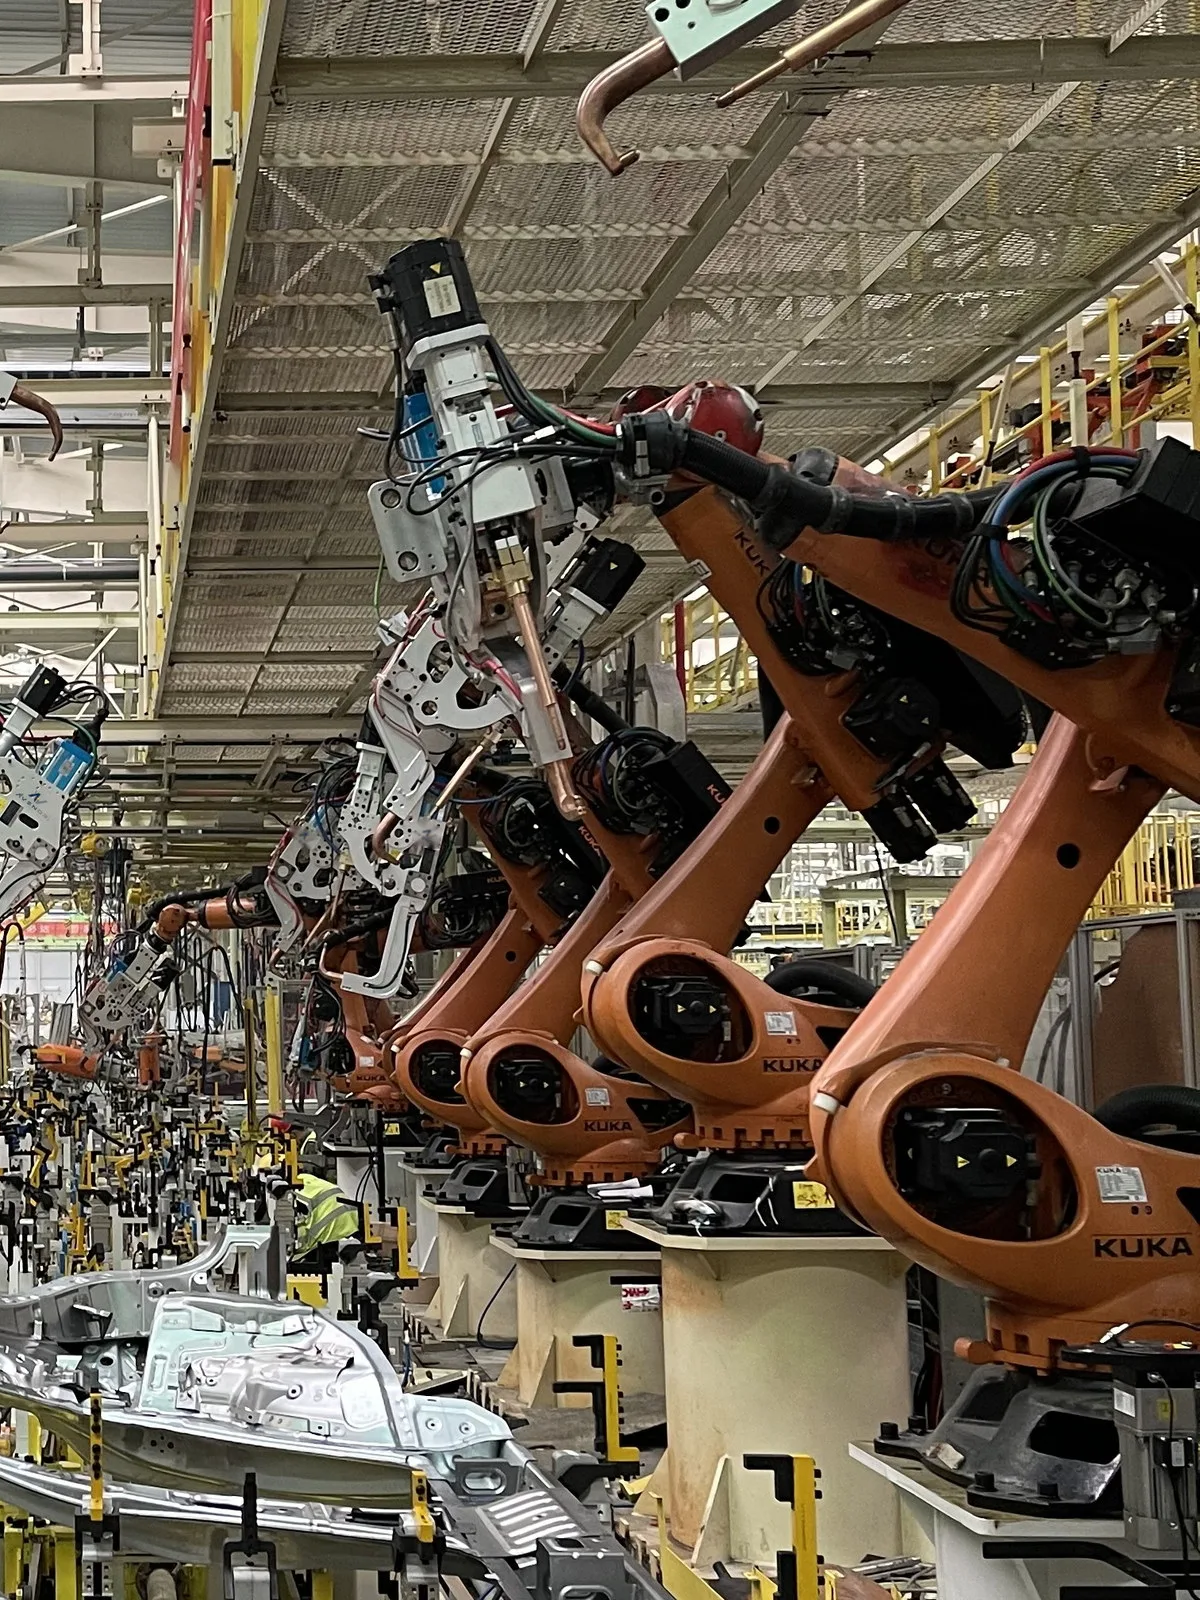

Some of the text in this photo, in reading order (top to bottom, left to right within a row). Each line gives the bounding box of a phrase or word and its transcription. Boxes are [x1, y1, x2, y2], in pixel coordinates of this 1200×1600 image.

[734, 531, 771, 577] KUK
[706, 783, 726, 804] KU
[762, 1058, 824, 1073] KUKA
[355, 1074, 387, 1082] KUKA
[583, 1120, 633, 1132] KUKA
[1094, 1237, 1194, 1258] KUKA
